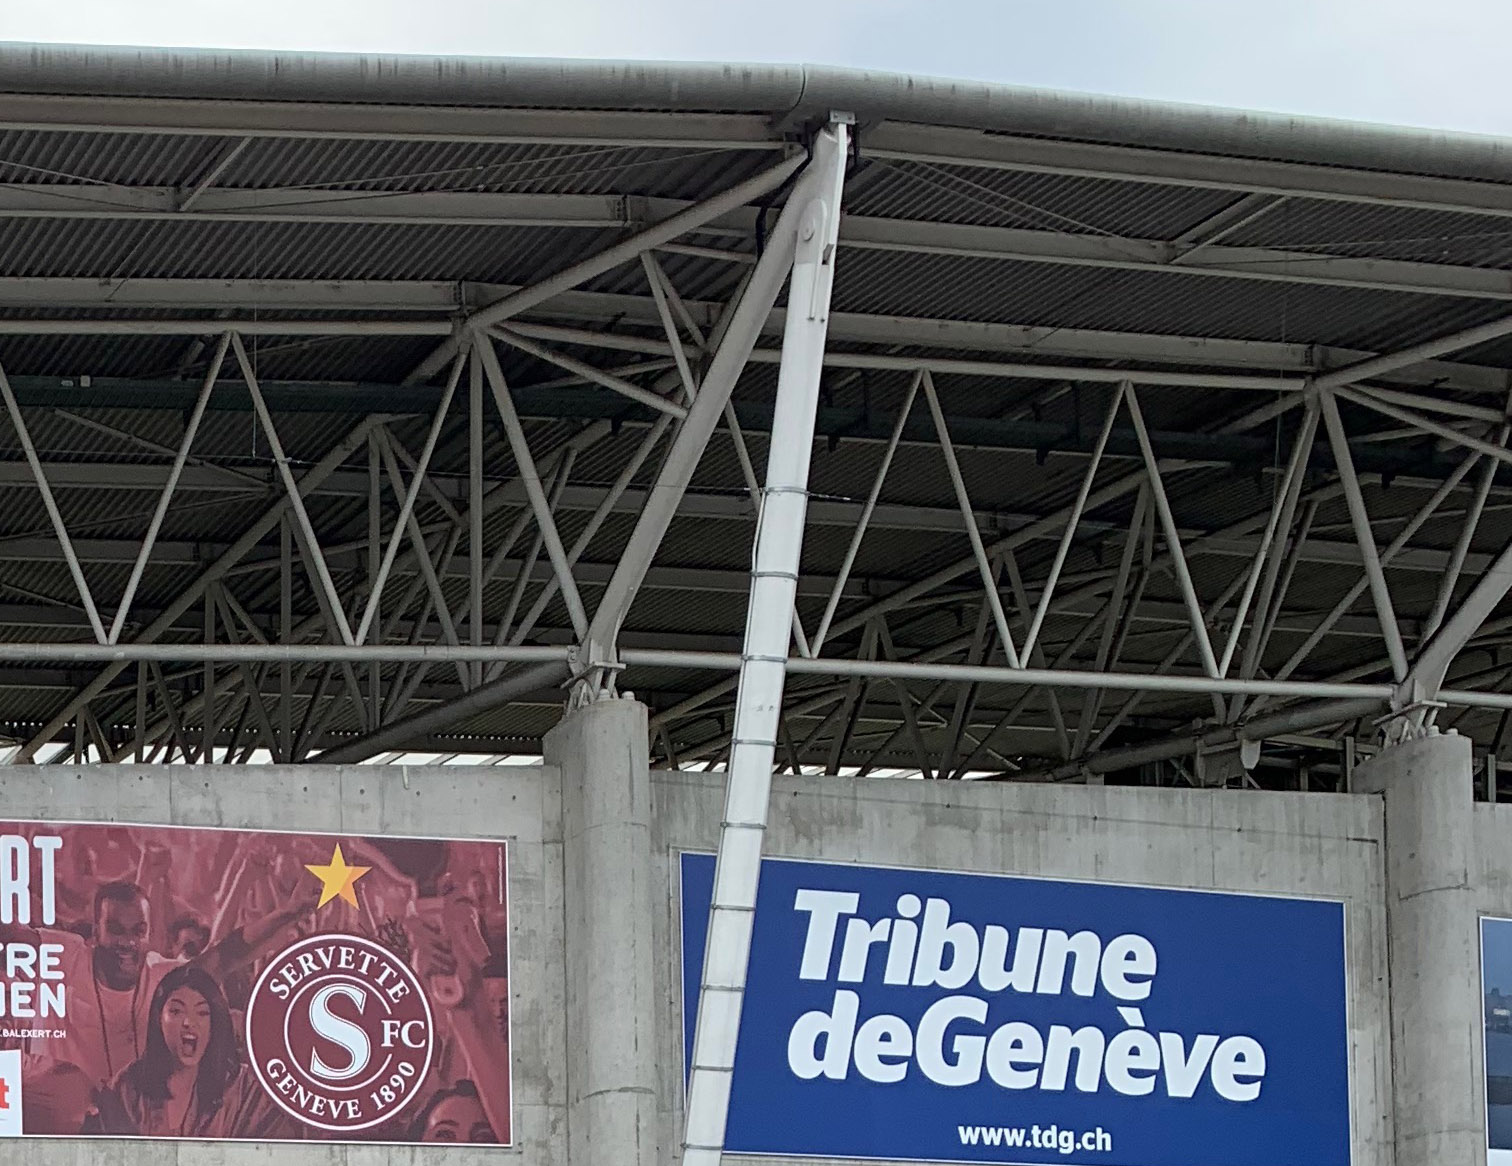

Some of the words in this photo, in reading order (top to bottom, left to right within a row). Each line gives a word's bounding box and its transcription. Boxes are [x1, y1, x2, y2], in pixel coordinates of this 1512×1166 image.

[793, 887, 1157, 1001] Tribune
[269, 946, 411, 1004] SERVETTE
[308, 984, 371, 1081] S
[381, 1019, 426, 1049] FC
[266, 1057, 362, 1120] GENEVE
[371, 1060, 416, 1112] 1890
[958, 1124, 1113, 1154] www.tdg.ch
